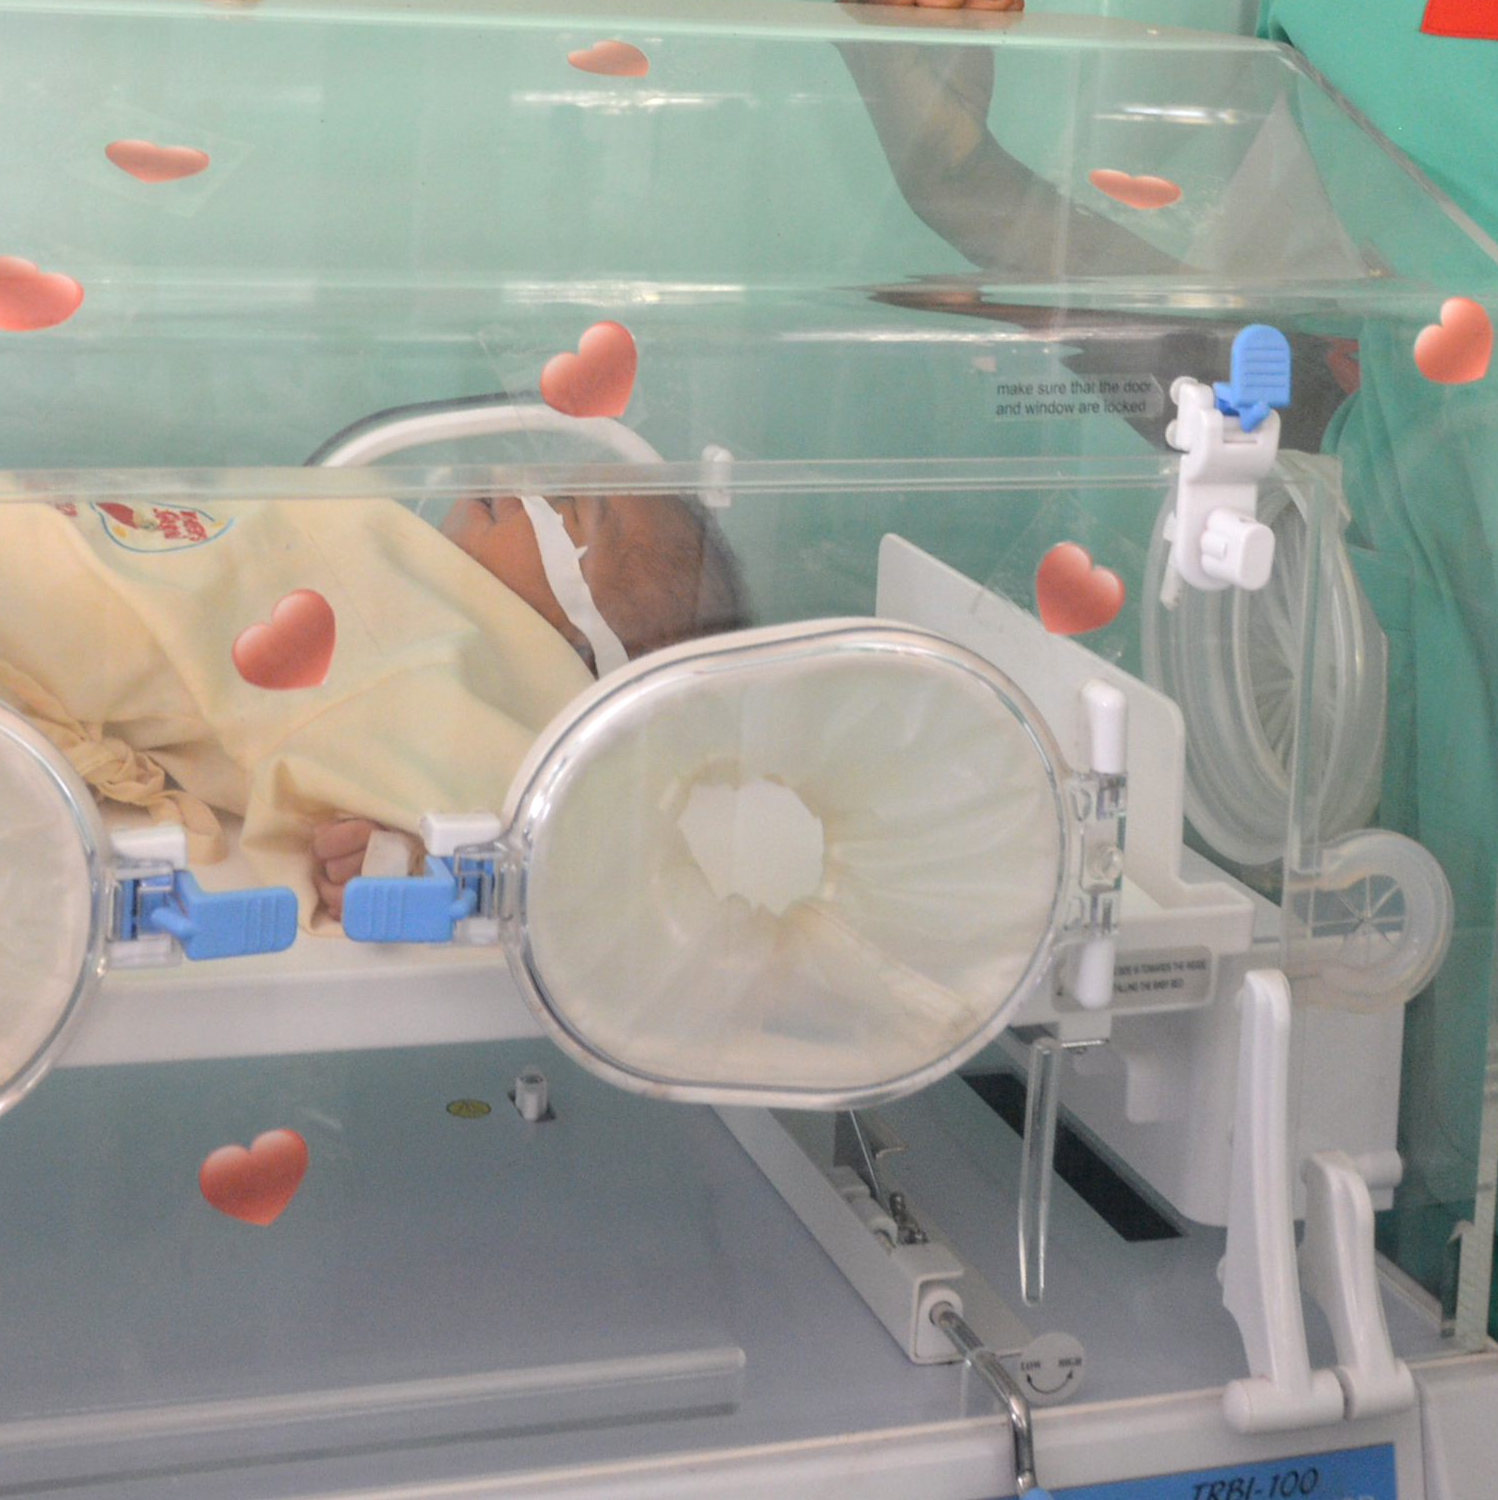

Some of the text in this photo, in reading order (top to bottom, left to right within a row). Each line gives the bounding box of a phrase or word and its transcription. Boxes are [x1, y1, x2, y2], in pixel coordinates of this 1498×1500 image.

[997, 380, 1151, 395] make sure that the door
[996, 400, 1146, 415] and window are locked
[1021, 1361, 1040, 1371] LOW
